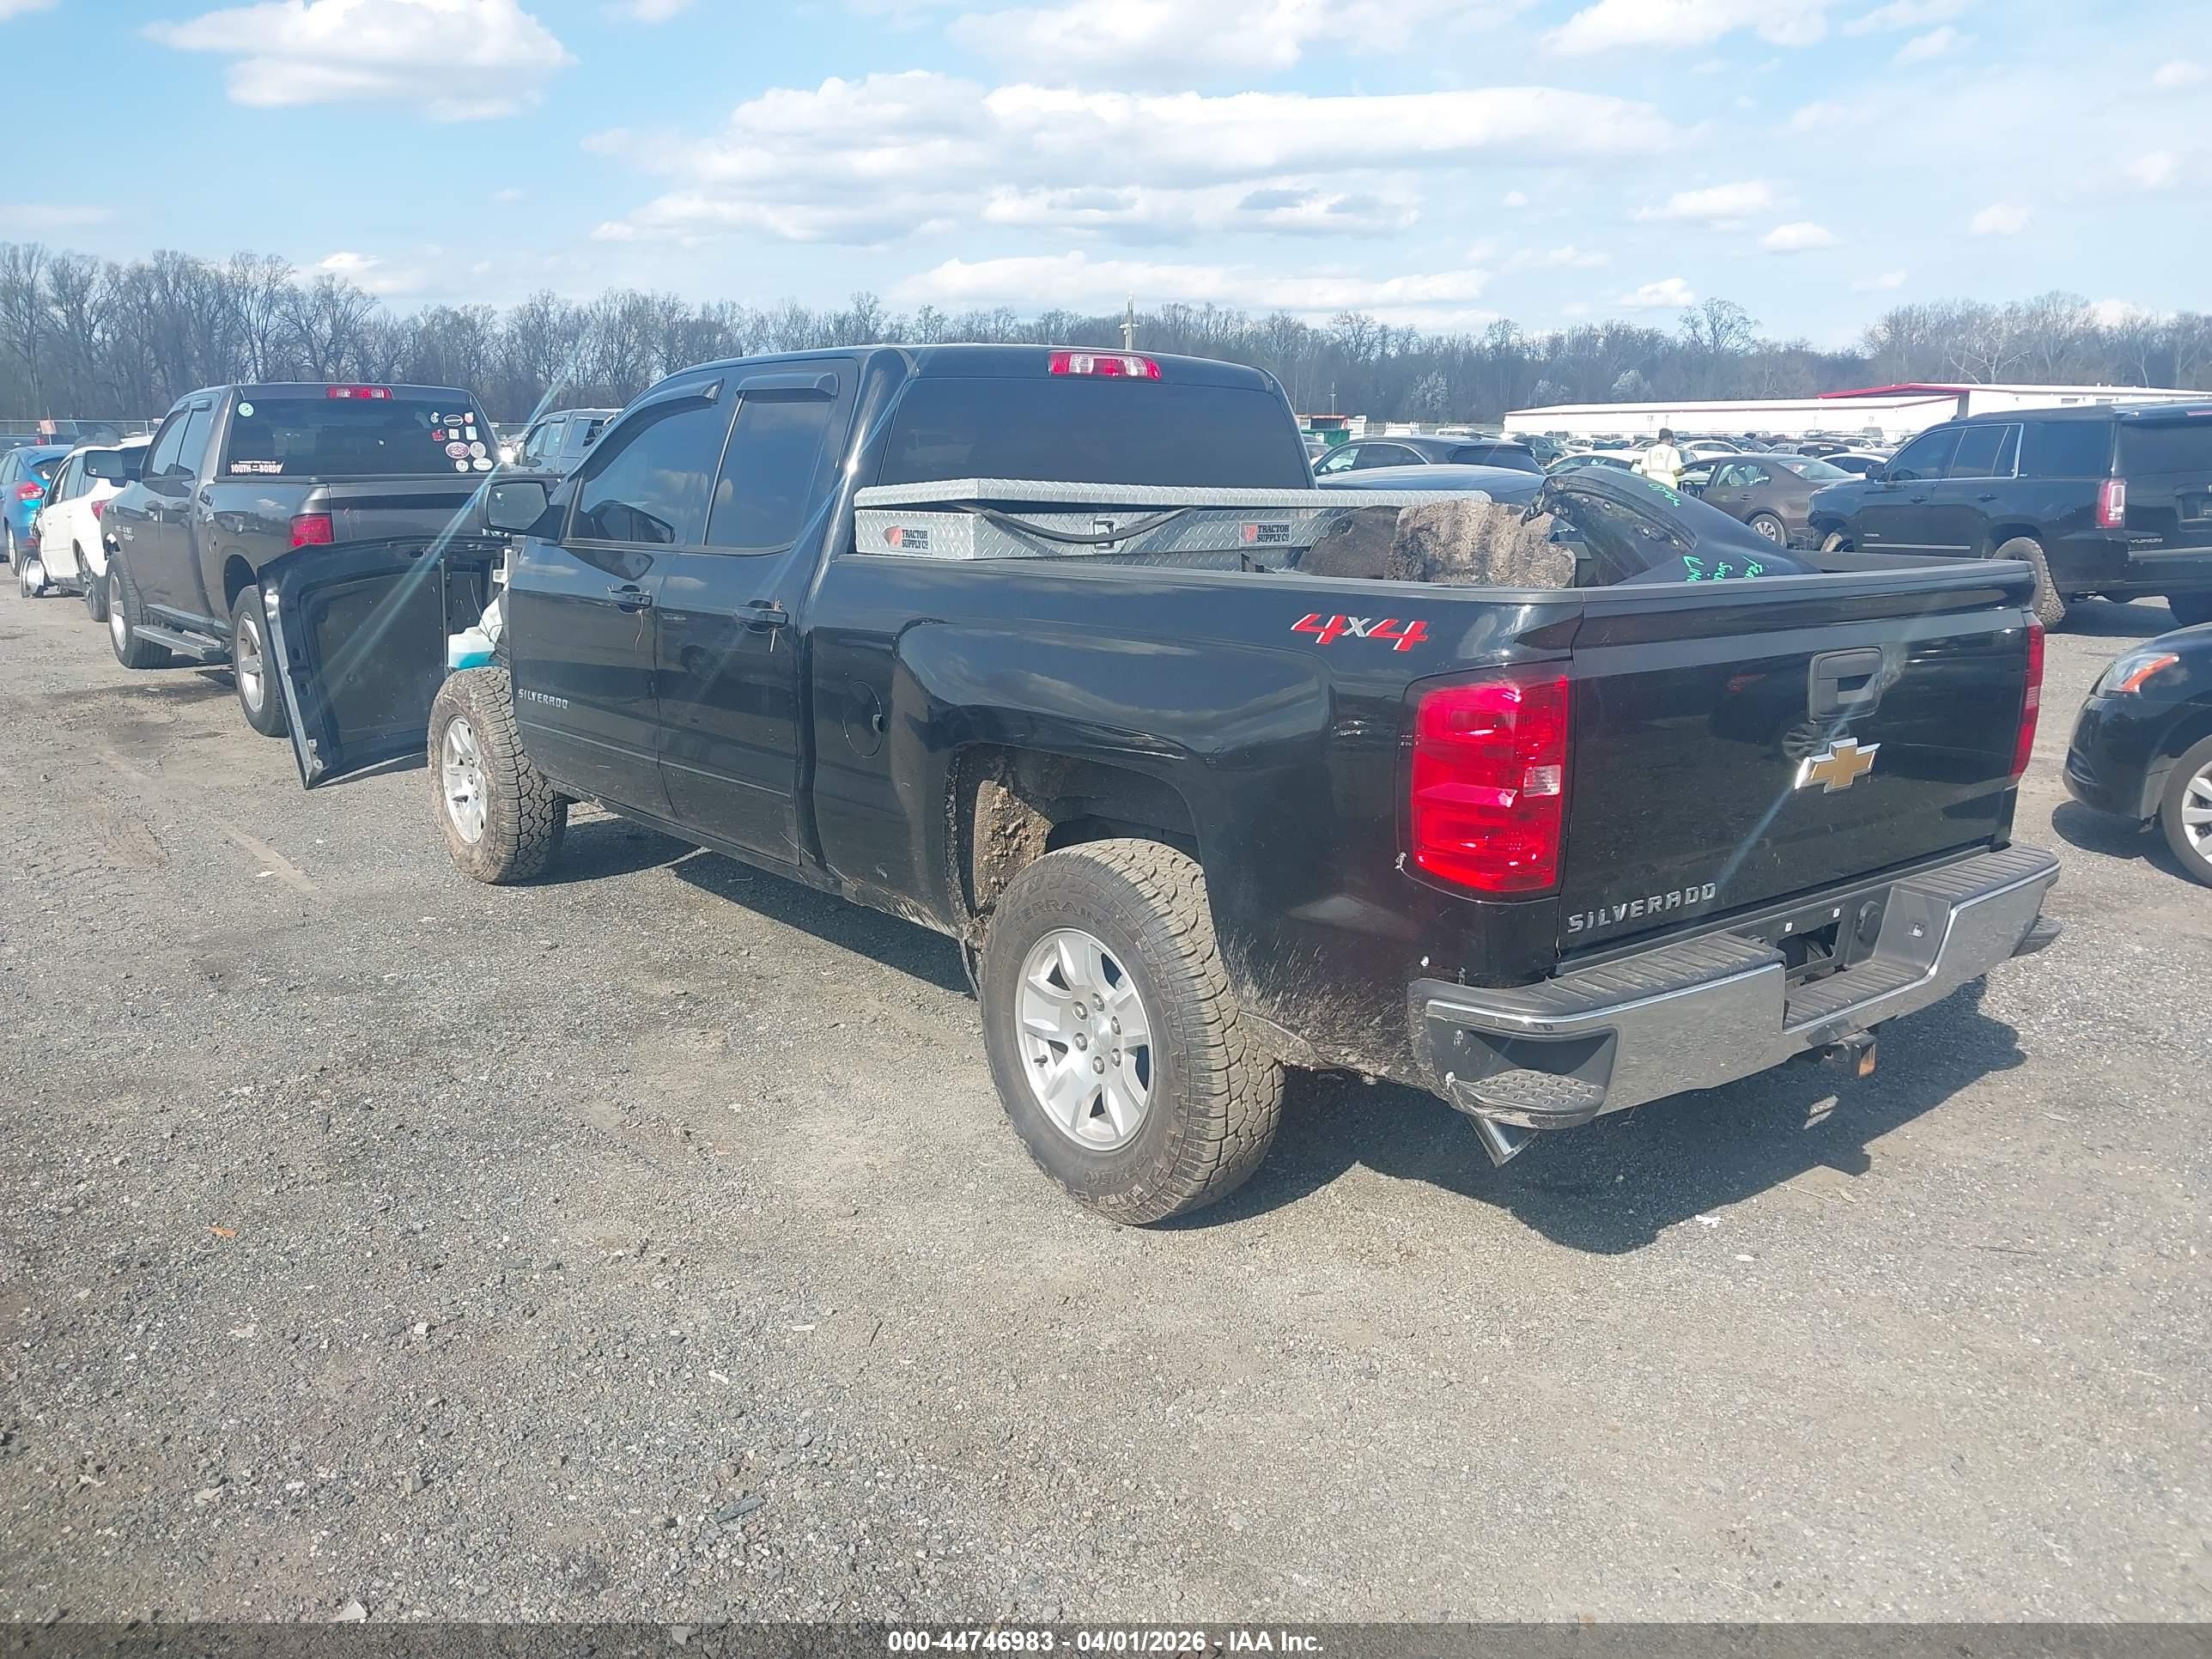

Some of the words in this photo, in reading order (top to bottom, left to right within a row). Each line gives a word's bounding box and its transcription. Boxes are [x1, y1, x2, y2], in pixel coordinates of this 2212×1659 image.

[902, 529, 928, 539] TRACTOR
[1257, 525, 1290, 534] TRACTOR
[1256, 533, 1282, 543] SUPPLY
[902, 539, 921, 549] SUPPLY
[518, 689, 568, 709] SILVERADO
[1567, 882, 1717, 934] SILVERADO
[1009, 898, 1102, 933] TERRAIN
